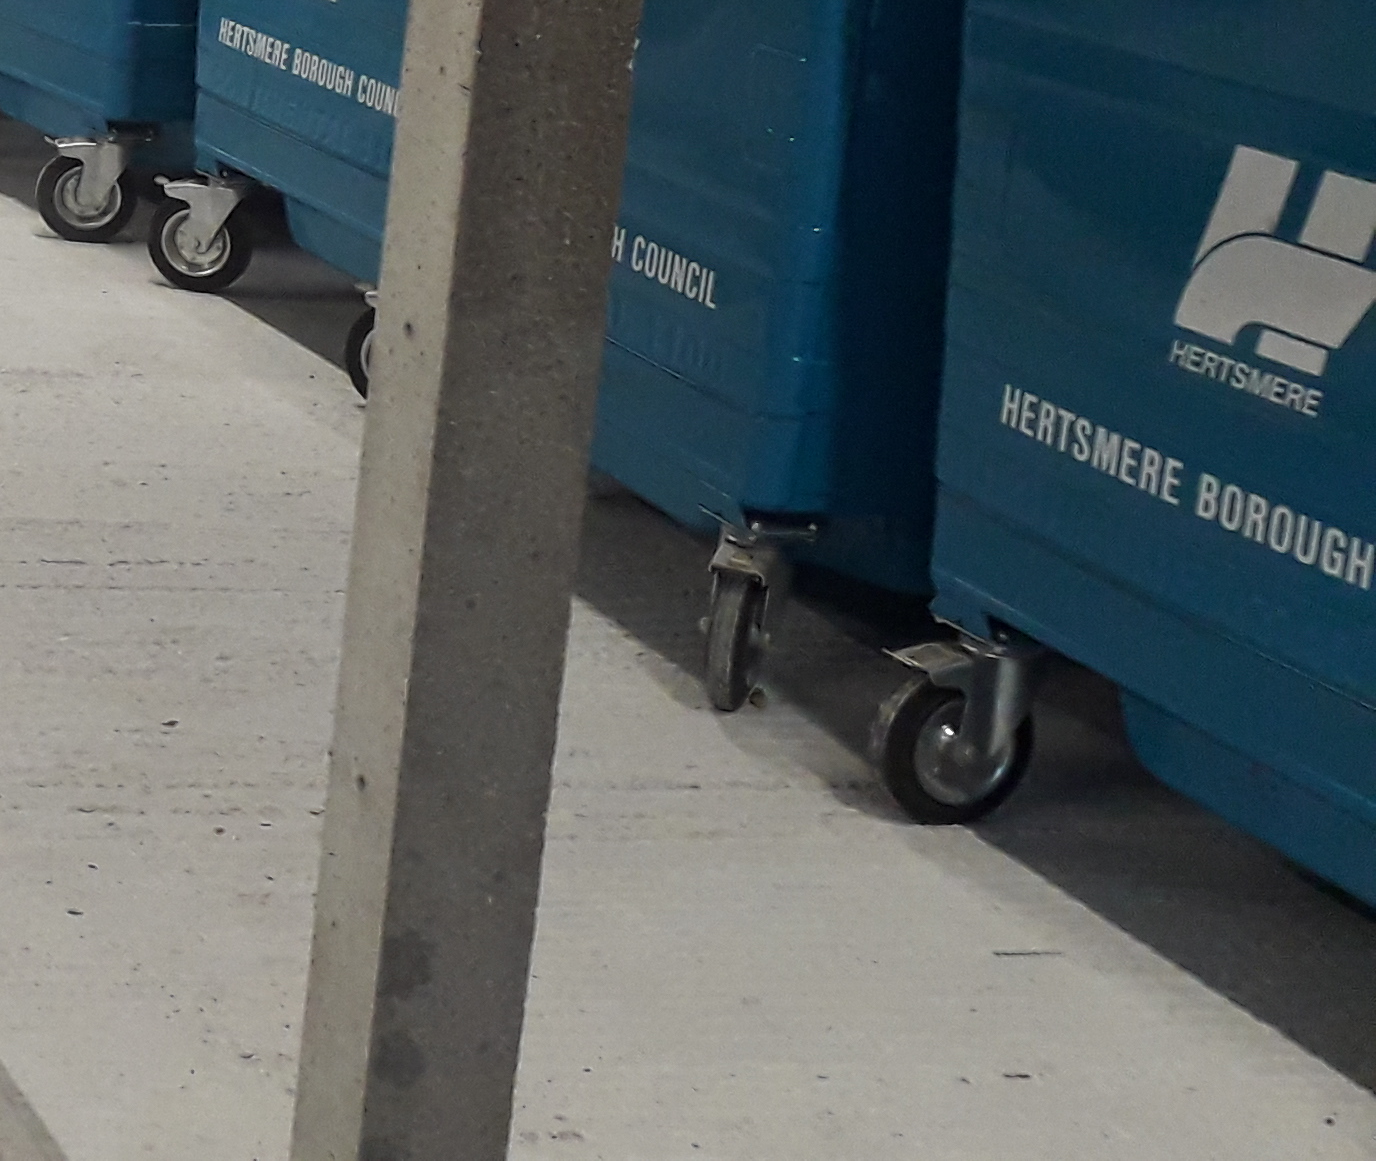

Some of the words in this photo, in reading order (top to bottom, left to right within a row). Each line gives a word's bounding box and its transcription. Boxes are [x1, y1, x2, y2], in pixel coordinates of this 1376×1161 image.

[218, 17, 291, 71] HERTSMERE
[291, 48, 355, 96] BOROUGH
[630, 235, 717, 310] COUNCIL
[1168, 340, 1325, 419] HERTSMERE
[999, 383, 1185, 508] HERTSMERE
[1194, 472, 1375, 592] BOROUGH
